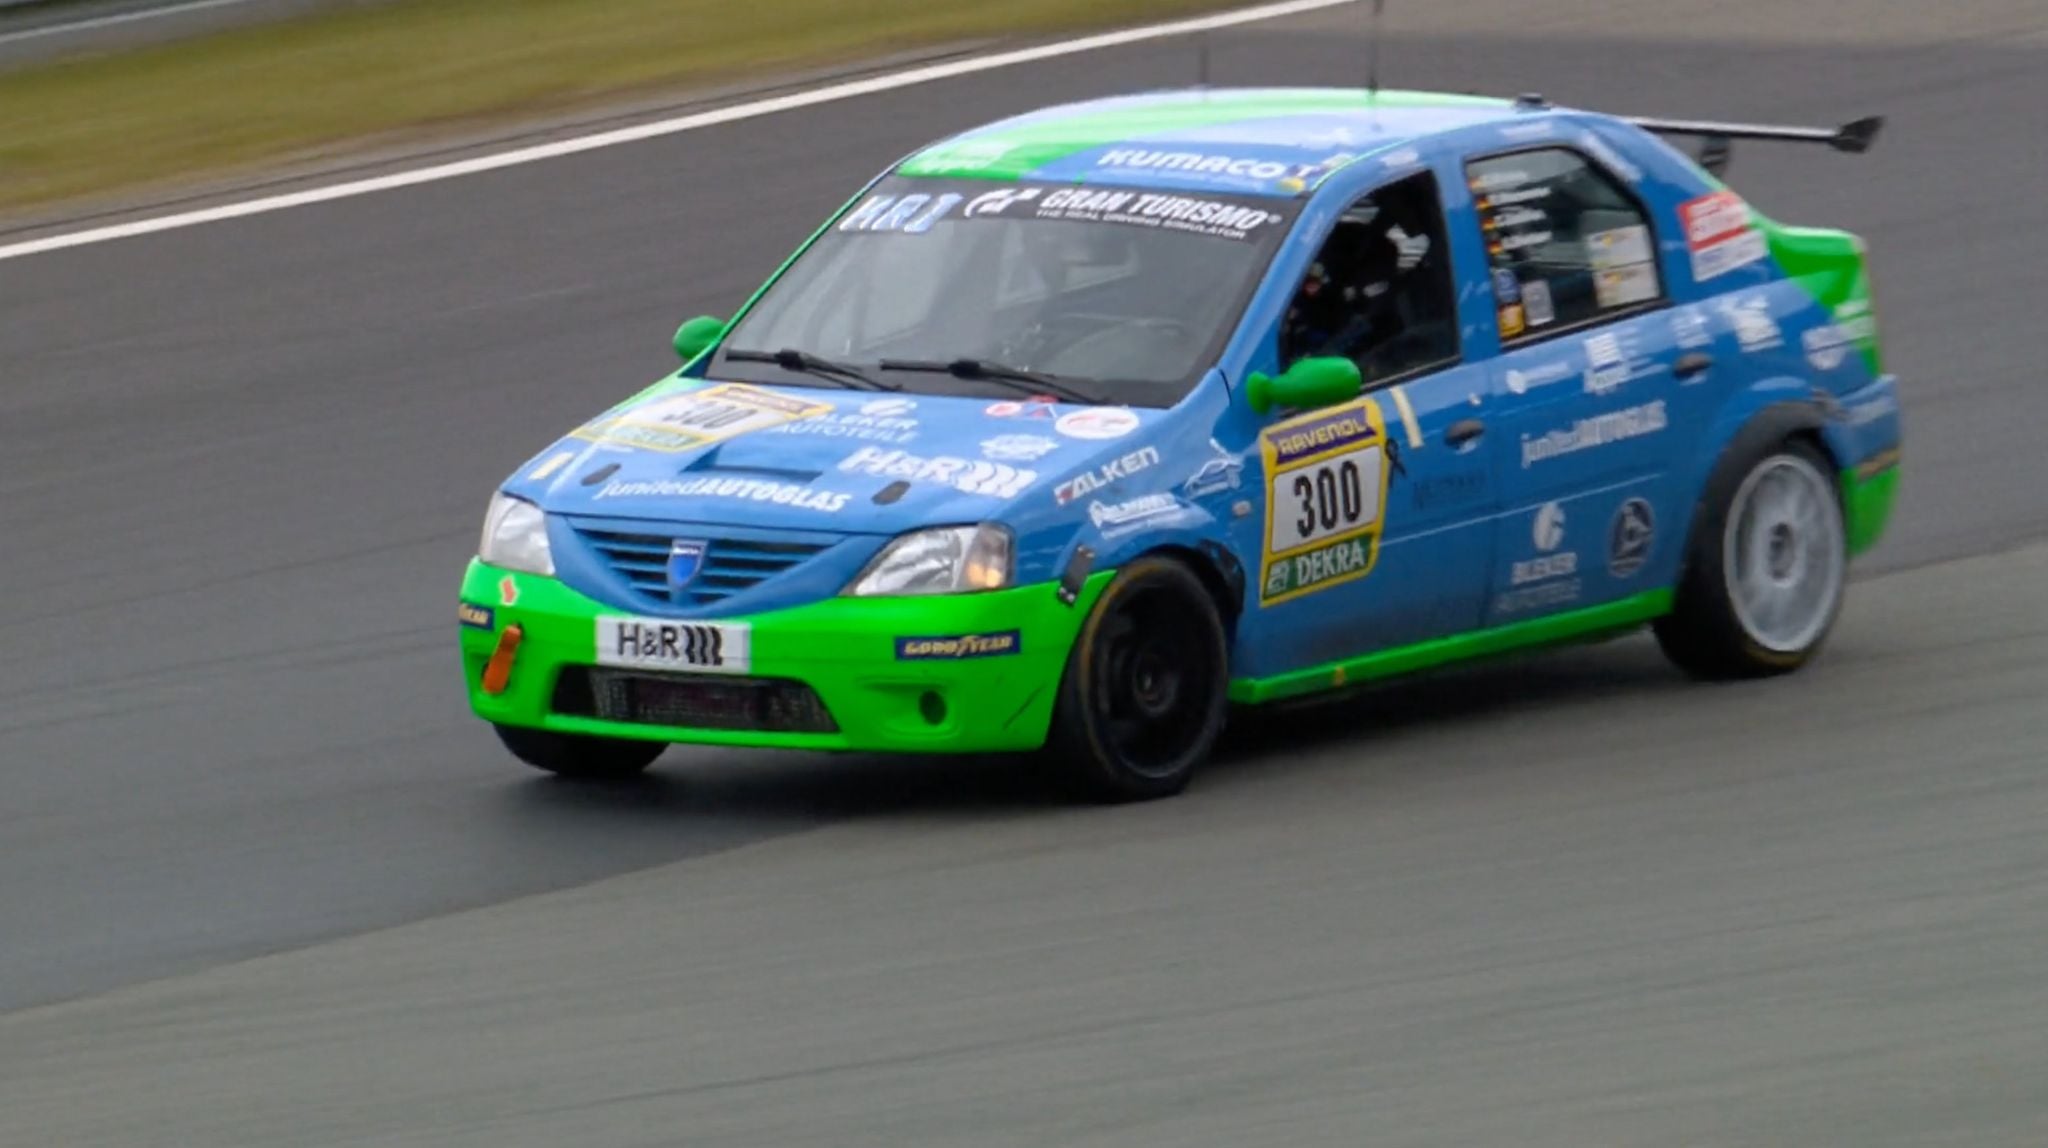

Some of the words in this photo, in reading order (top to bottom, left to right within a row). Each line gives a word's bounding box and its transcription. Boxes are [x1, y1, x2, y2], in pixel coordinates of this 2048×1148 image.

[1098, 149, 1288, 179] KUMACO
[1040, 187, 1135, 211] GRAN
[1278, 417, 1368, 456] RAVENOL
[1293, 460, 1362, 538] 300
[1297, 538, 1365, 587] DEKRA
[617, 622, 680, 659] H&R
[904, 634, 1013, 657] GOODYEAR
